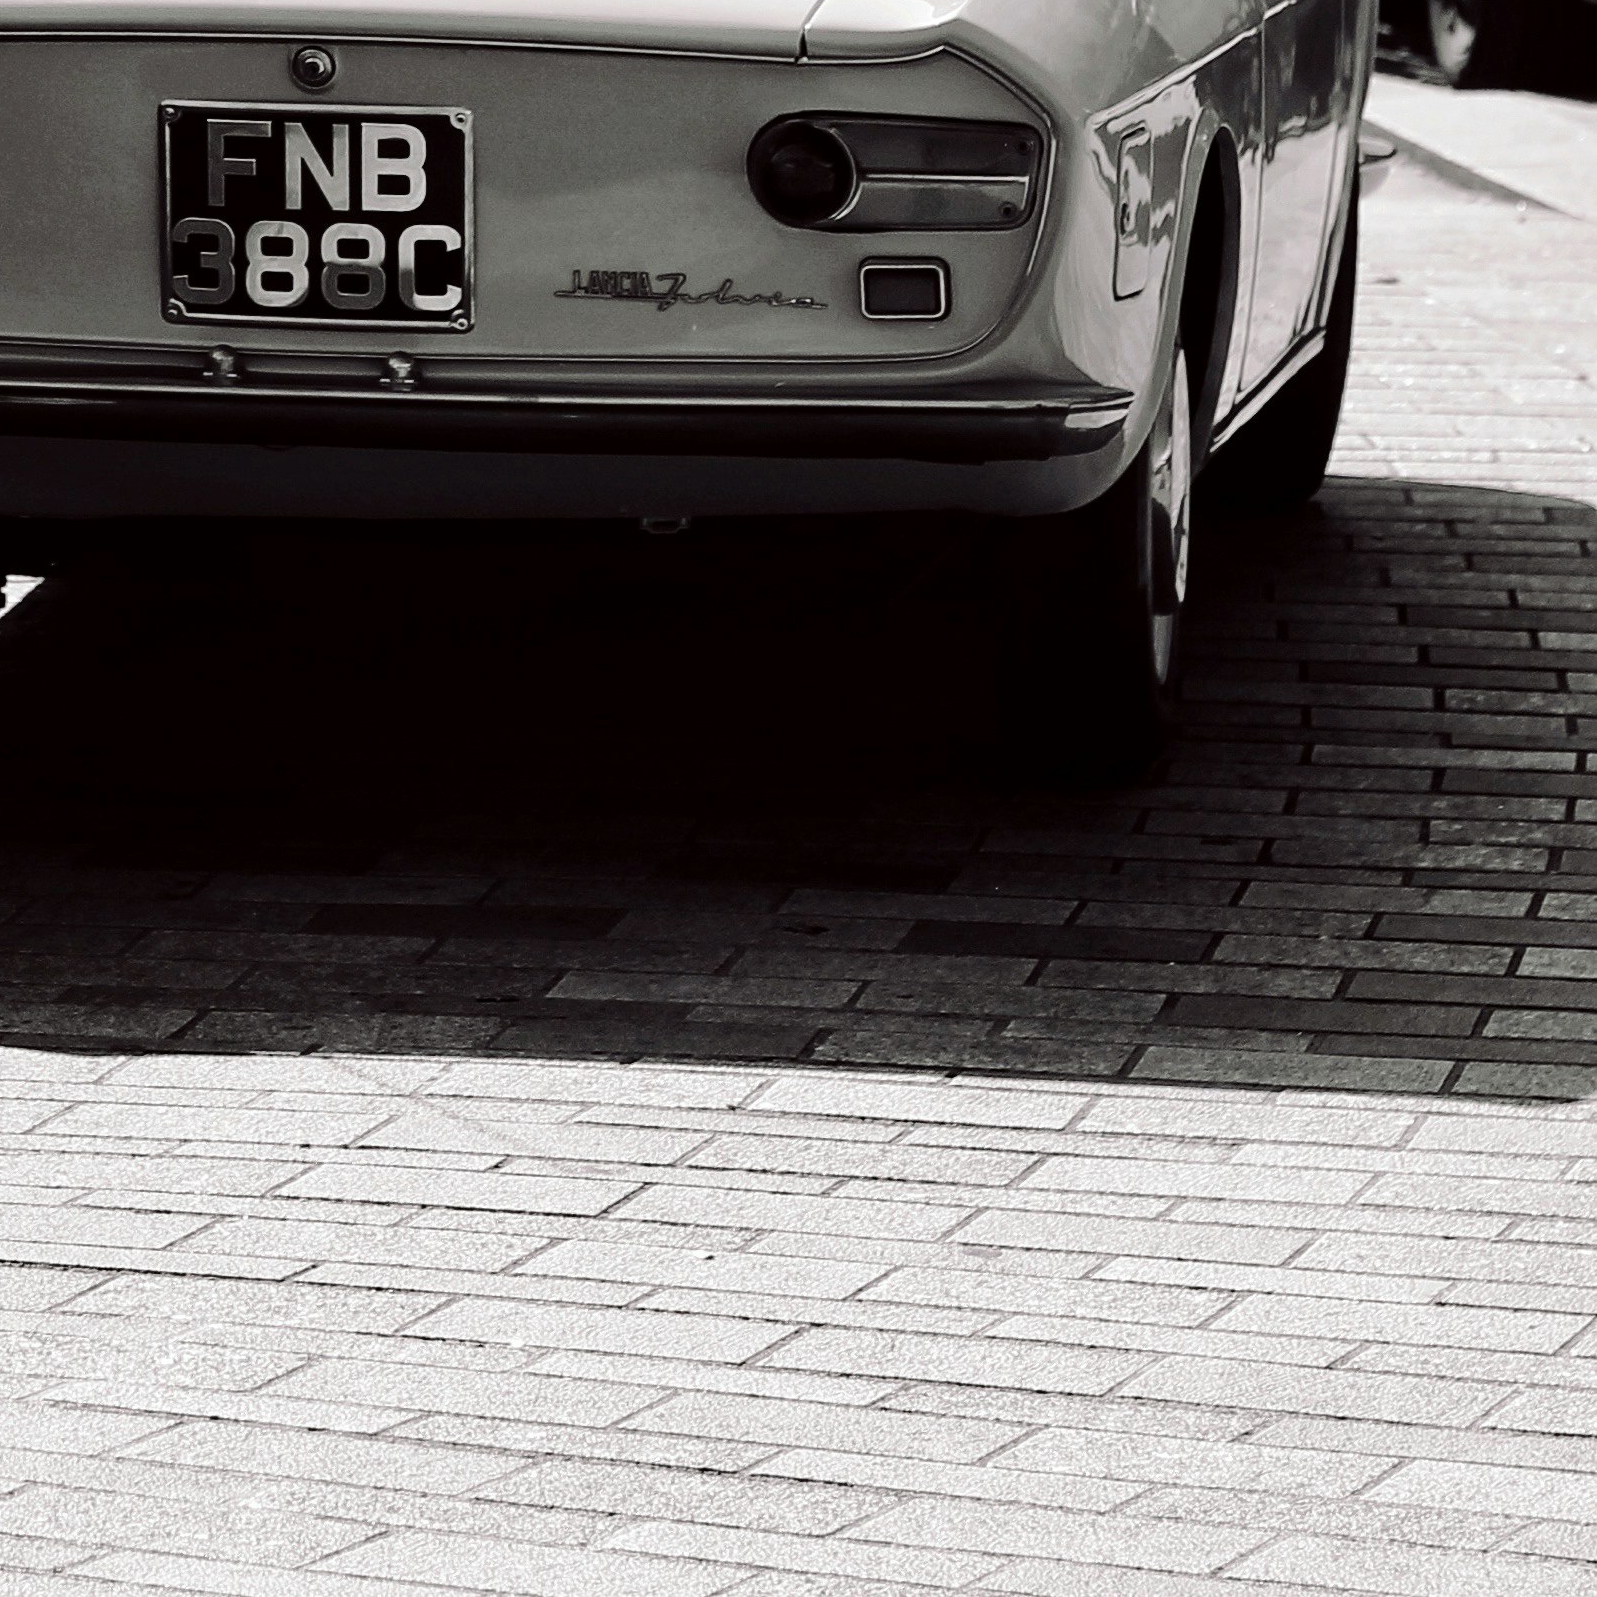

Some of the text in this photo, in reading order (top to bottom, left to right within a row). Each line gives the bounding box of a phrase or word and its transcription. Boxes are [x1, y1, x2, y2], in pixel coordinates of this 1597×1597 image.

[207, 119, 427, 212] FNB
[172, 217, 462, 312] 388C
[571, 268, 653, 297] LANCIA
